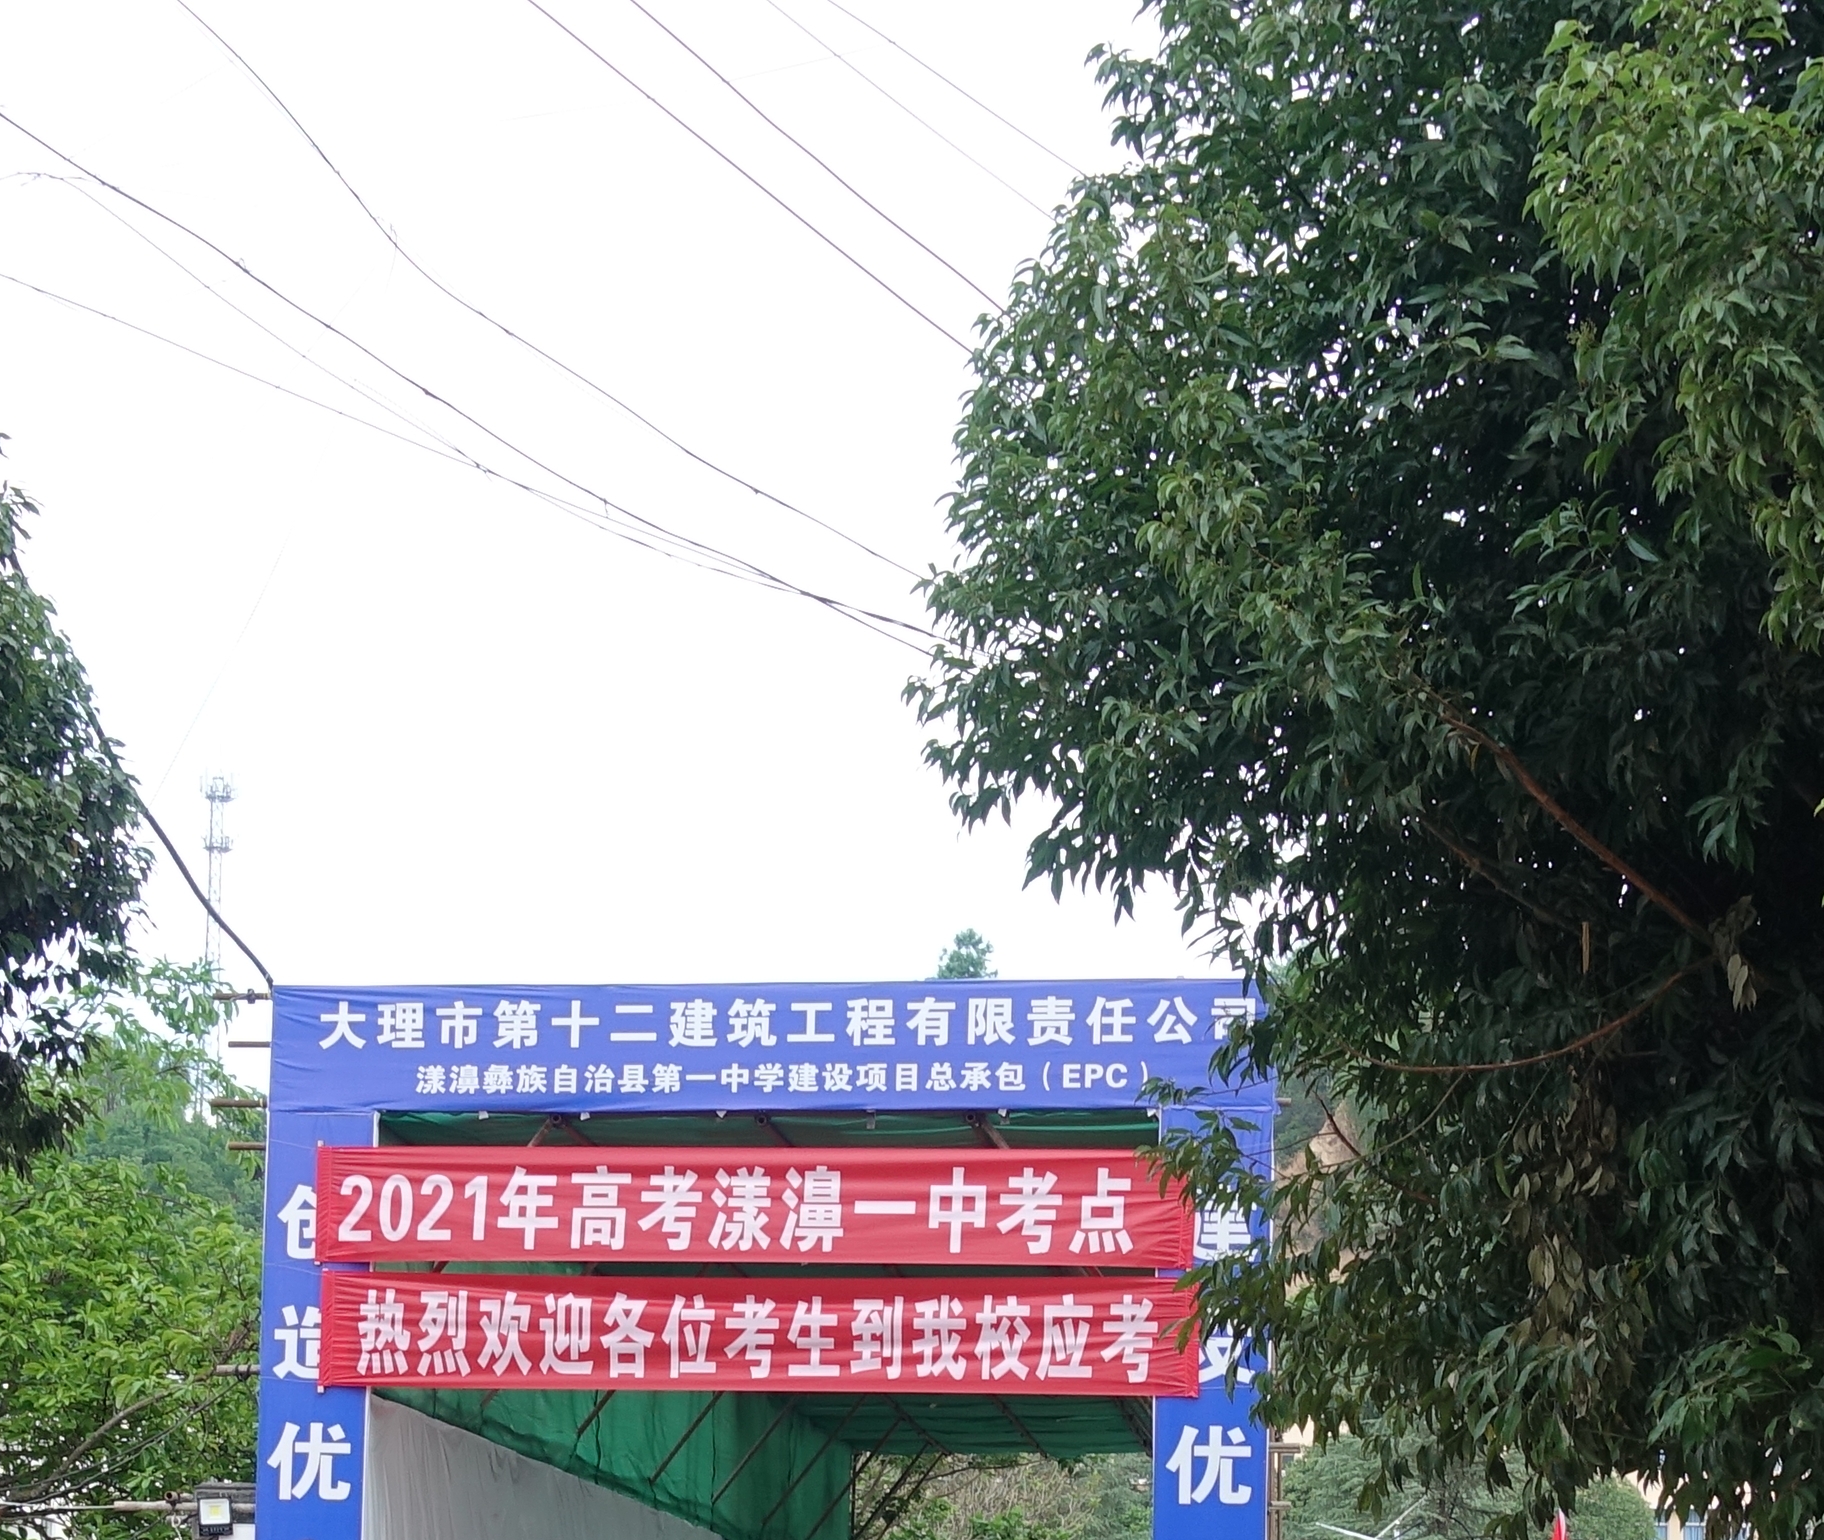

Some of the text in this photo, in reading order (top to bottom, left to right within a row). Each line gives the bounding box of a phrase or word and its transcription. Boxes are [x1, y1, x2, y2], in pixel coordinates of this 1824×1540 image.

[318, 996, 1257, 1050] 大理市第十二建筑工程有限责任公司
[337, 1164, 1134, 1257] 2021年高考漾濞一中考点
[357, 1288, 1159, 1384] 热烈欢迎各位考生到我校应考
